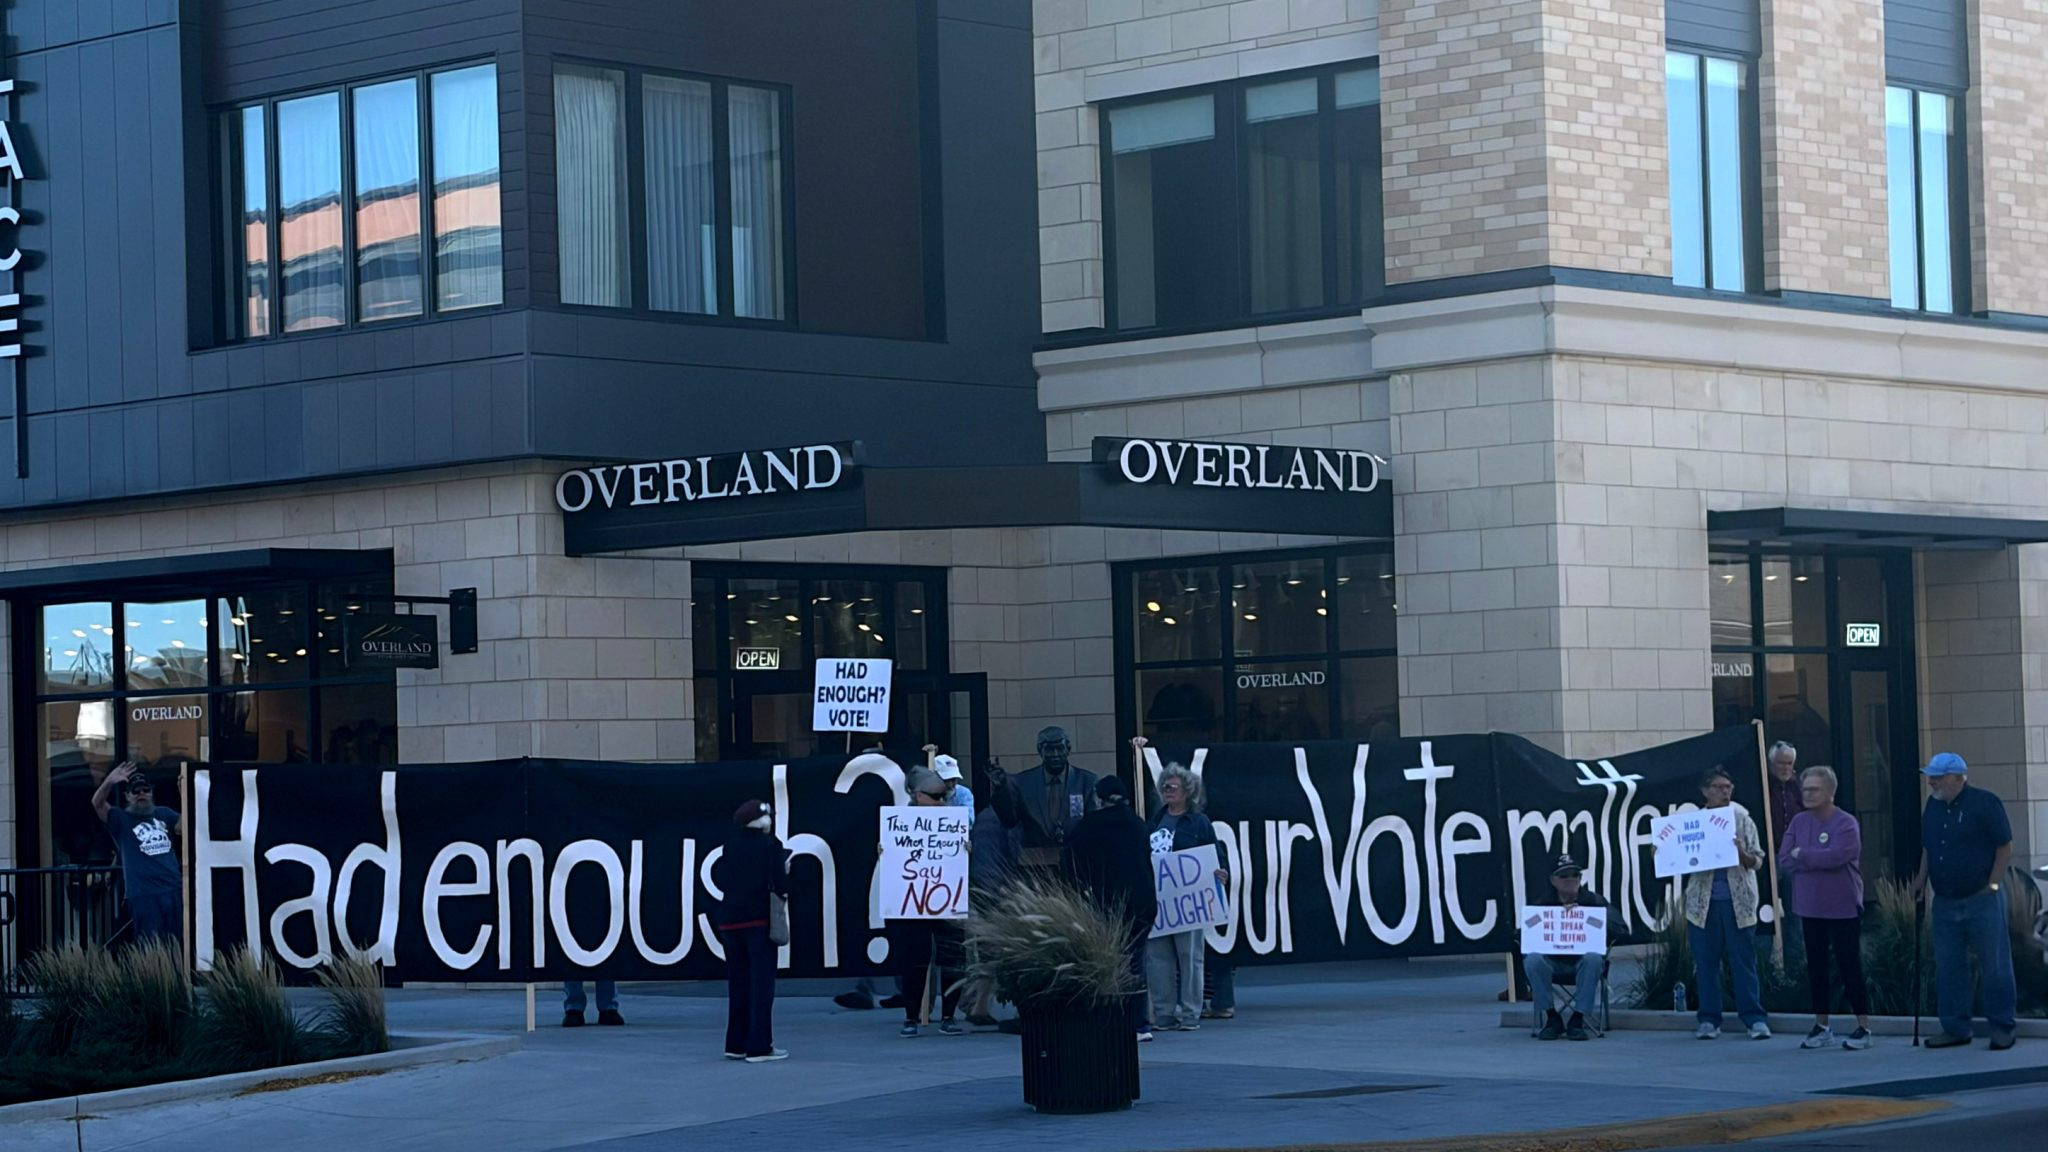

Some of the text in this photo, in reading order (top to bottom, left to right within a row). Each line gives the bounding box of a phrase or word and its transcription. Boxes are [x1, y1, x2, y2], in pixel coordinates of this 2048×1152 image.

[1120, 439, 1379, 492] OVERLAND
[555, 444, 842, 512] OVERLAND
[1849, 628, 1878, 643] OPEN
[361, 640, 432, 653] OVERLAND
[740, 651, 776, 667] OPEN
[835, 662, 868, 679] HAD
[1236, 671, 1325, 689] OVERLAND
[817, 685, 886, 704] ENOUGH?
[132, 705, 203, 722] OVERLAND
[828, 709, 870, 727] VOTE!
[886, 814, 967, 834] This All Ends
[894, 834, 924, 848] When
[194, 769, 401, 971] Had
[1294, 741, 1498, 945] Vote
[901, 858, 943, 884] Say
[1157, 854, 1202, 892] AD
[900, 876, 963, 916] NO!
